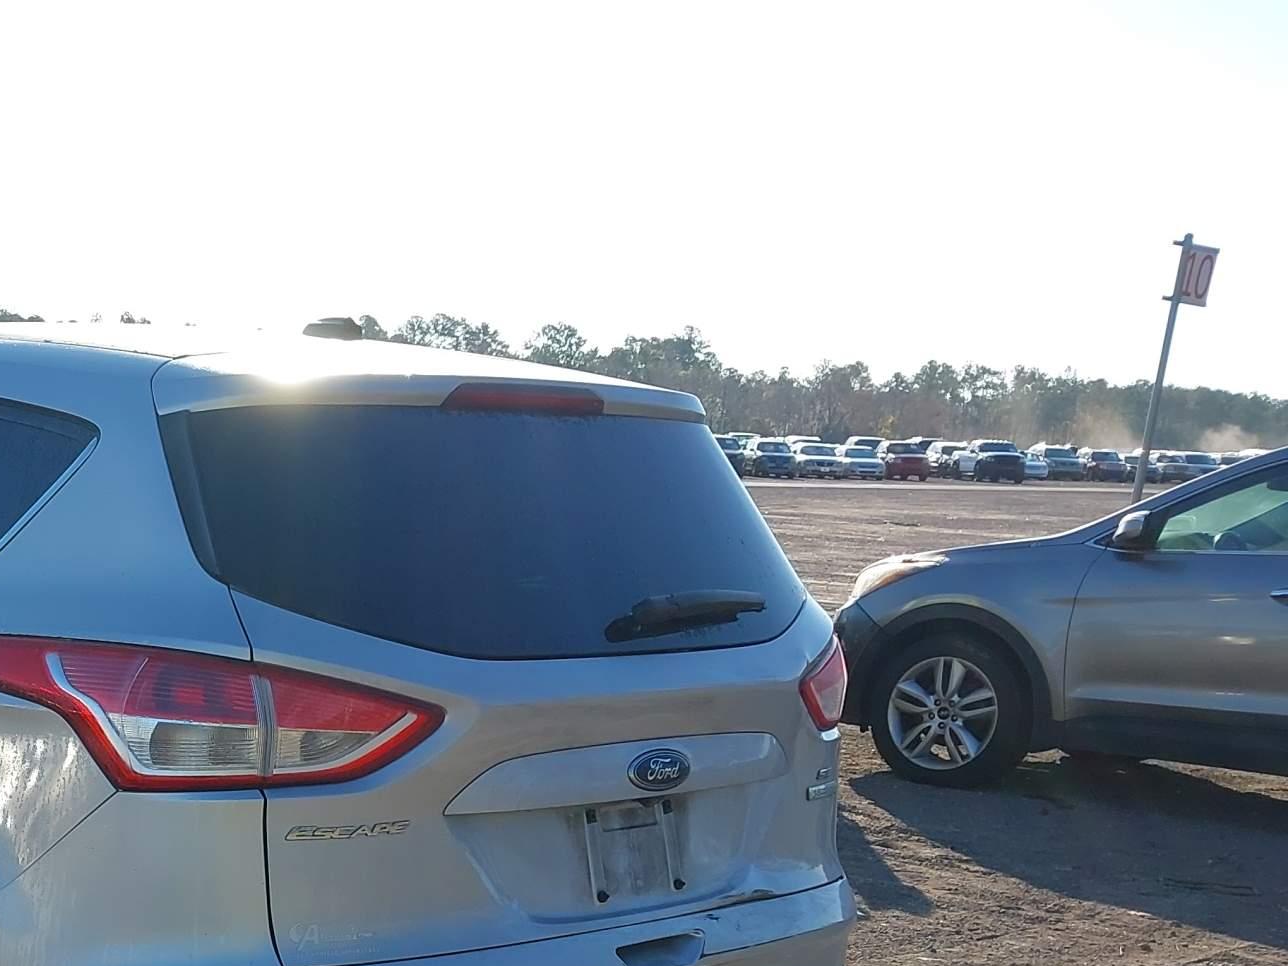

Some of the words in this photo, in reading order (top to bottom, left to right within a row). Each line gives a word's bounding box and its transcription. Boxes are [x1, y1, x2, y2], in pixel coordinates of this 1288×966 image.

[1182, 252, 1214, 299] 10
[647, 758, 680, 780] Ford
[284, 819, 411, 841] ESCAPE
